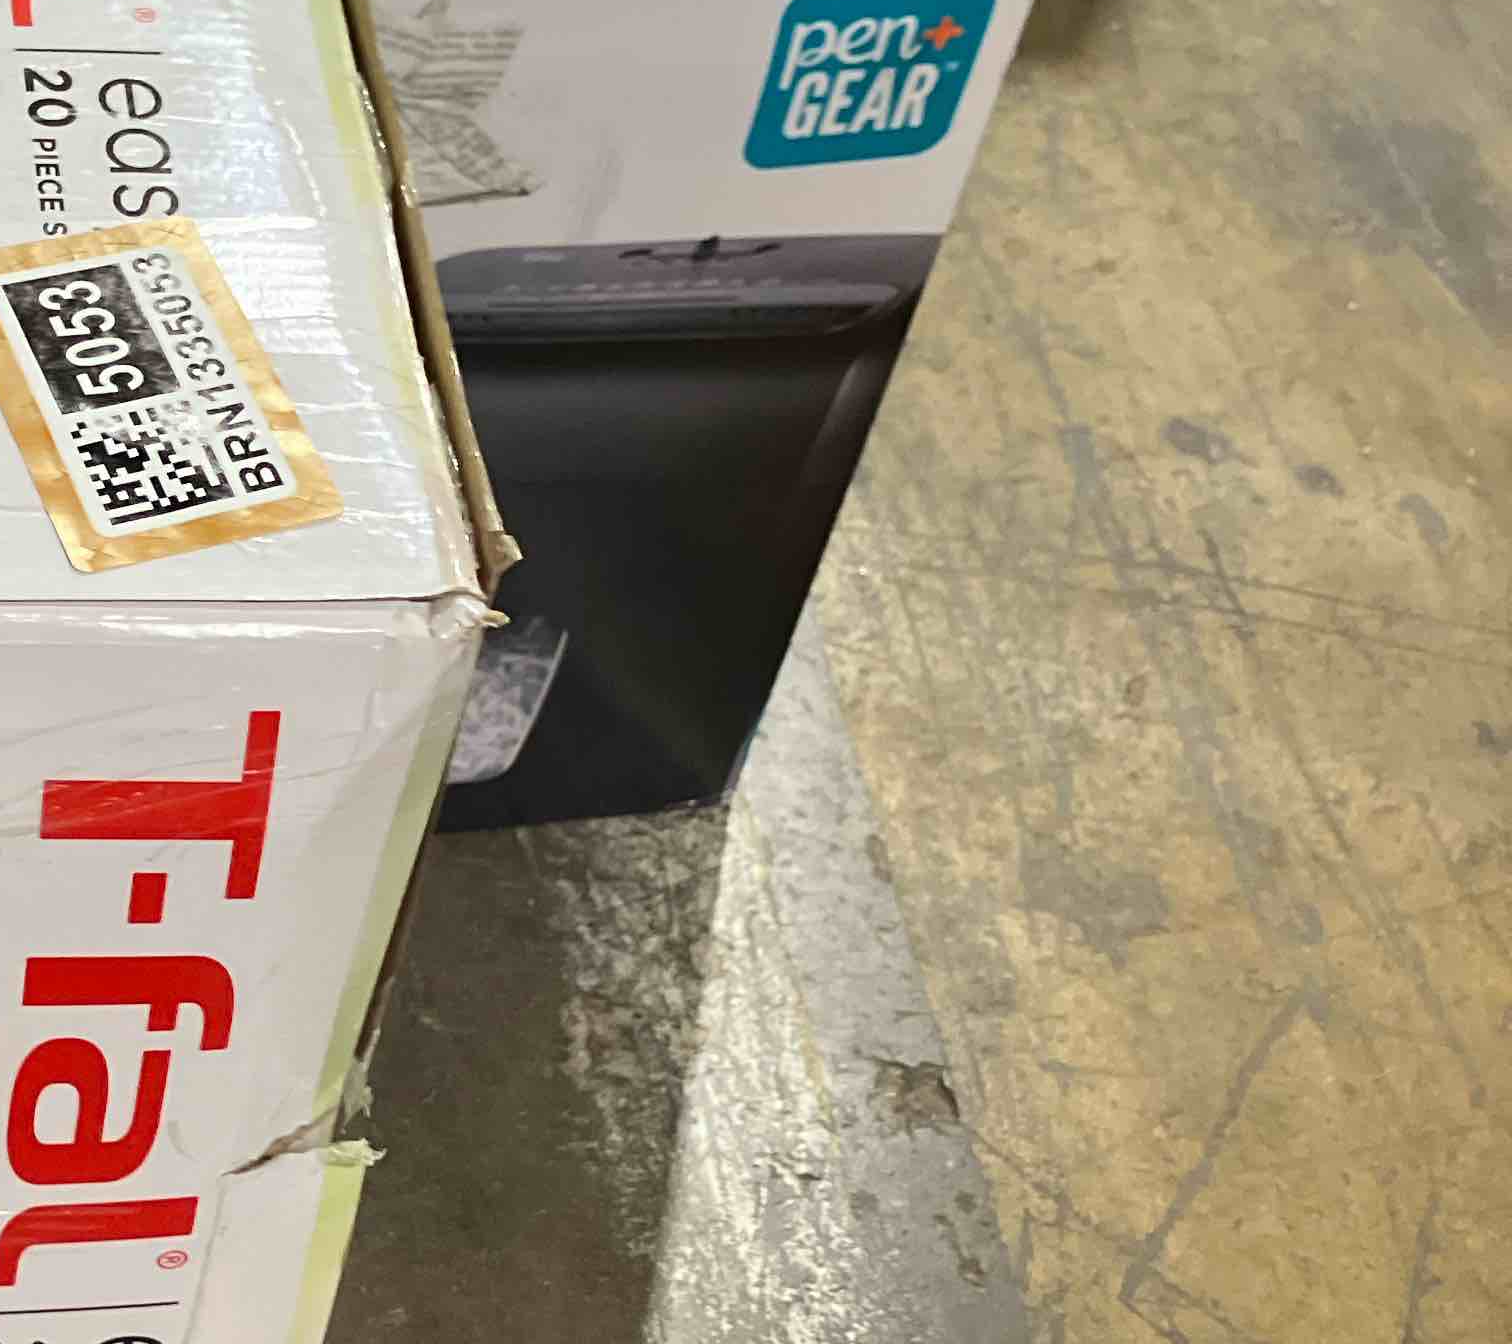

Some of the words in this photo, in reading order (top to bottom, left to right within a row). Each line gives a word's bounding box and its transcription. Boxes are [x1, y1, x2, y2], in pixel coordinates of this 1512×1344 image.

[24, 67, 77, 127] 20
[783, 63, 941, 140] GEAR
[32, 139, 65, 212] PIECE
[98, 77, 179, 230] eas
[39, 278, 145, 396] 5053
[132, 252, 286, 494] BRN1335053
